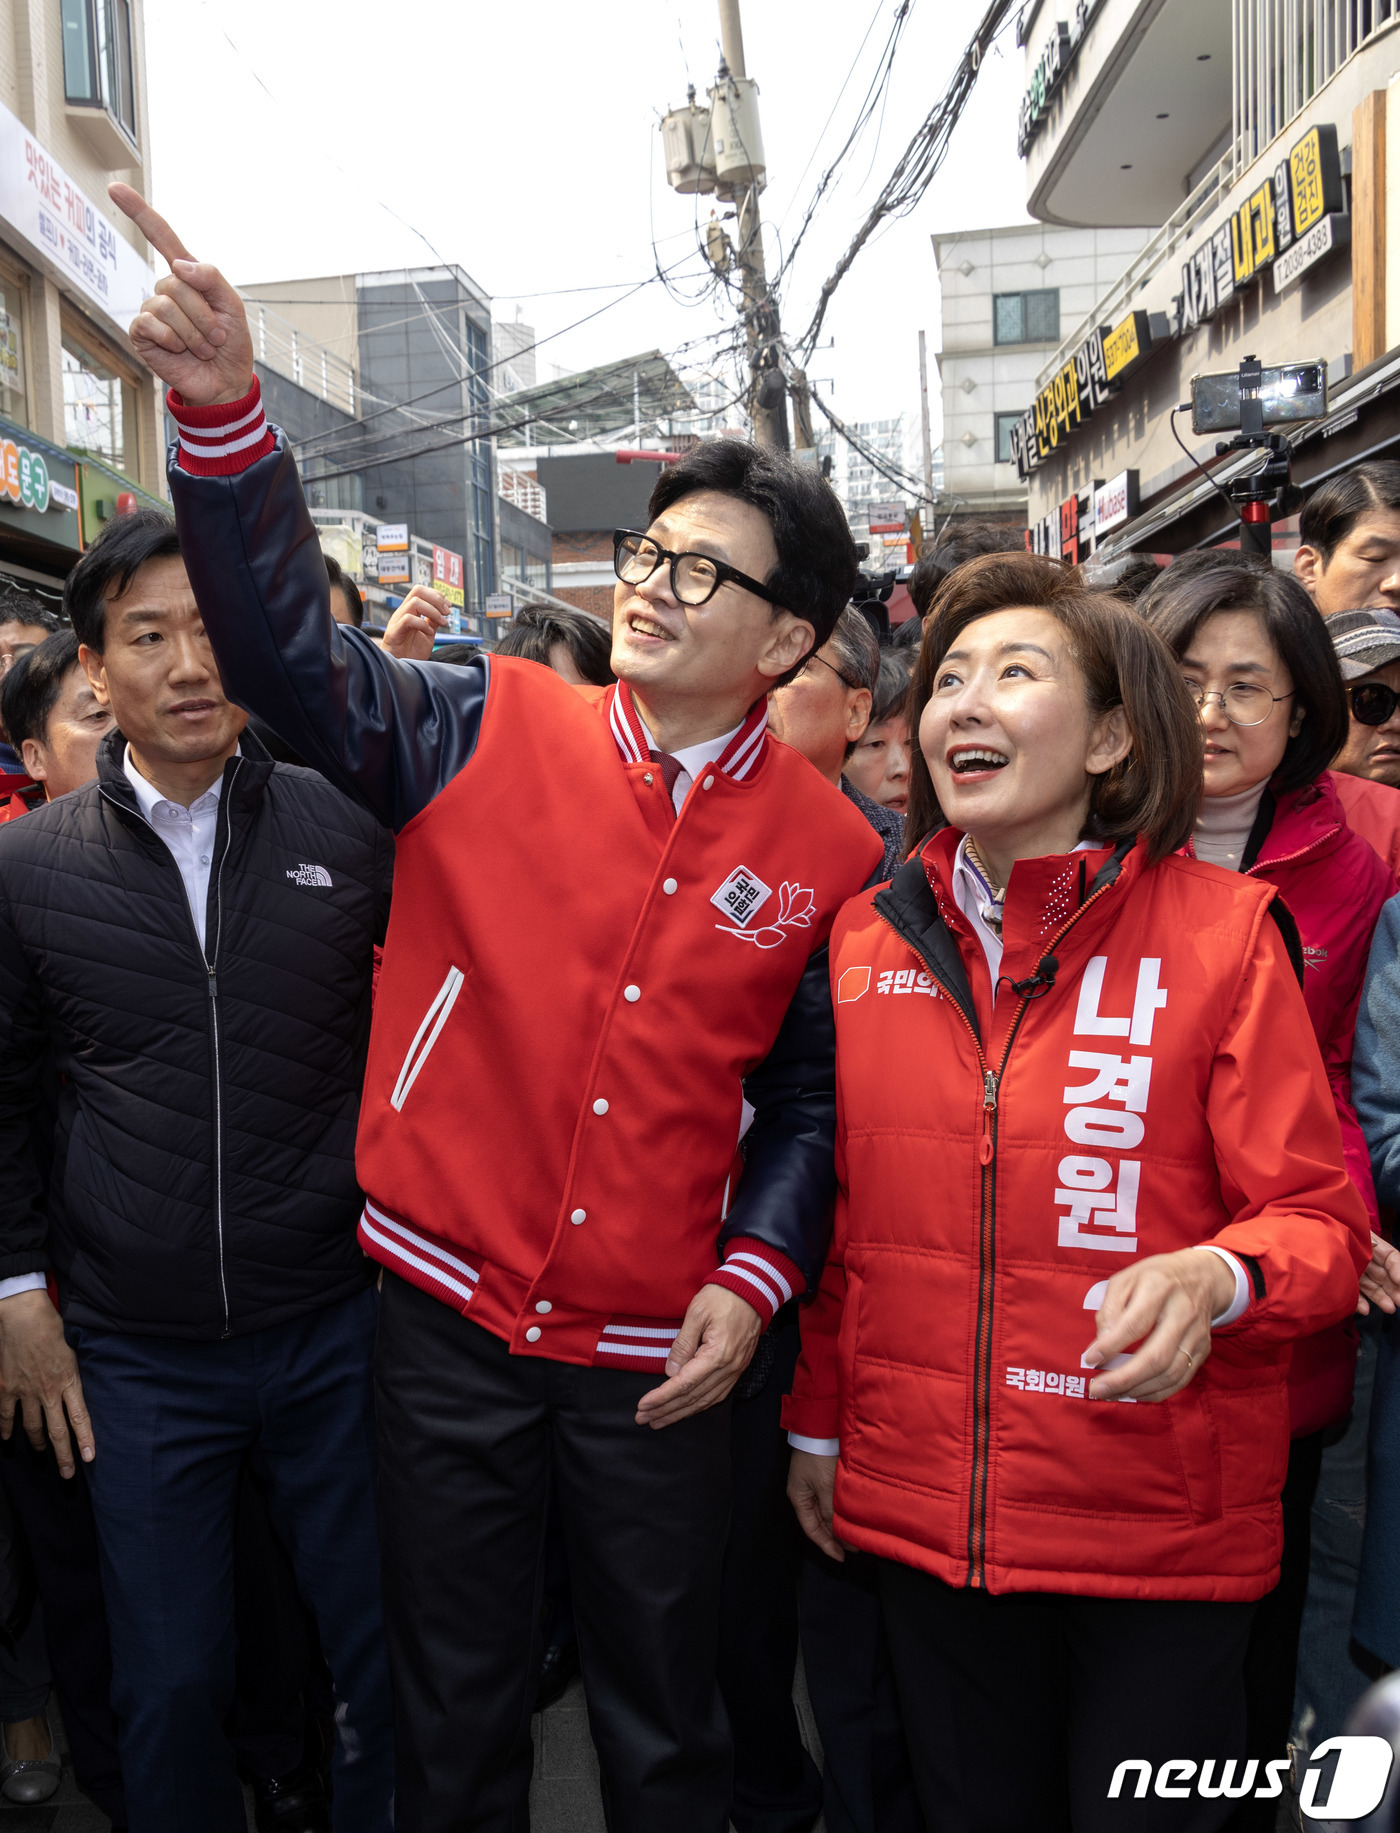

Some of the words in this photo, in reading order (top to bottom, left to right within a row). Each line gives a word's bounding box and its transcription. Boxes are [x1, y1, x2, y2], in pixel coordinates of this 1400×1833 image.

[1293, 136, 1317, 186] 건강
[25, 138, 62, 213] 맛있는
[64, 180, 97, 248] 커피의
[98, 218, 118, 271] 공식
[1296, 181, 1320, 226] 검진
[0, 446, 46, 499] 도문구
[286, 870, 317, 879] NORTH
[296, 877, 318, 886] FACE
[298, 863, 315, 872] THE
[876, 969, 943, 999] 국민의
[1054, 956, 1168, 1253] 나경원
[1006, 1366, 1086, 1399] 국회의원
